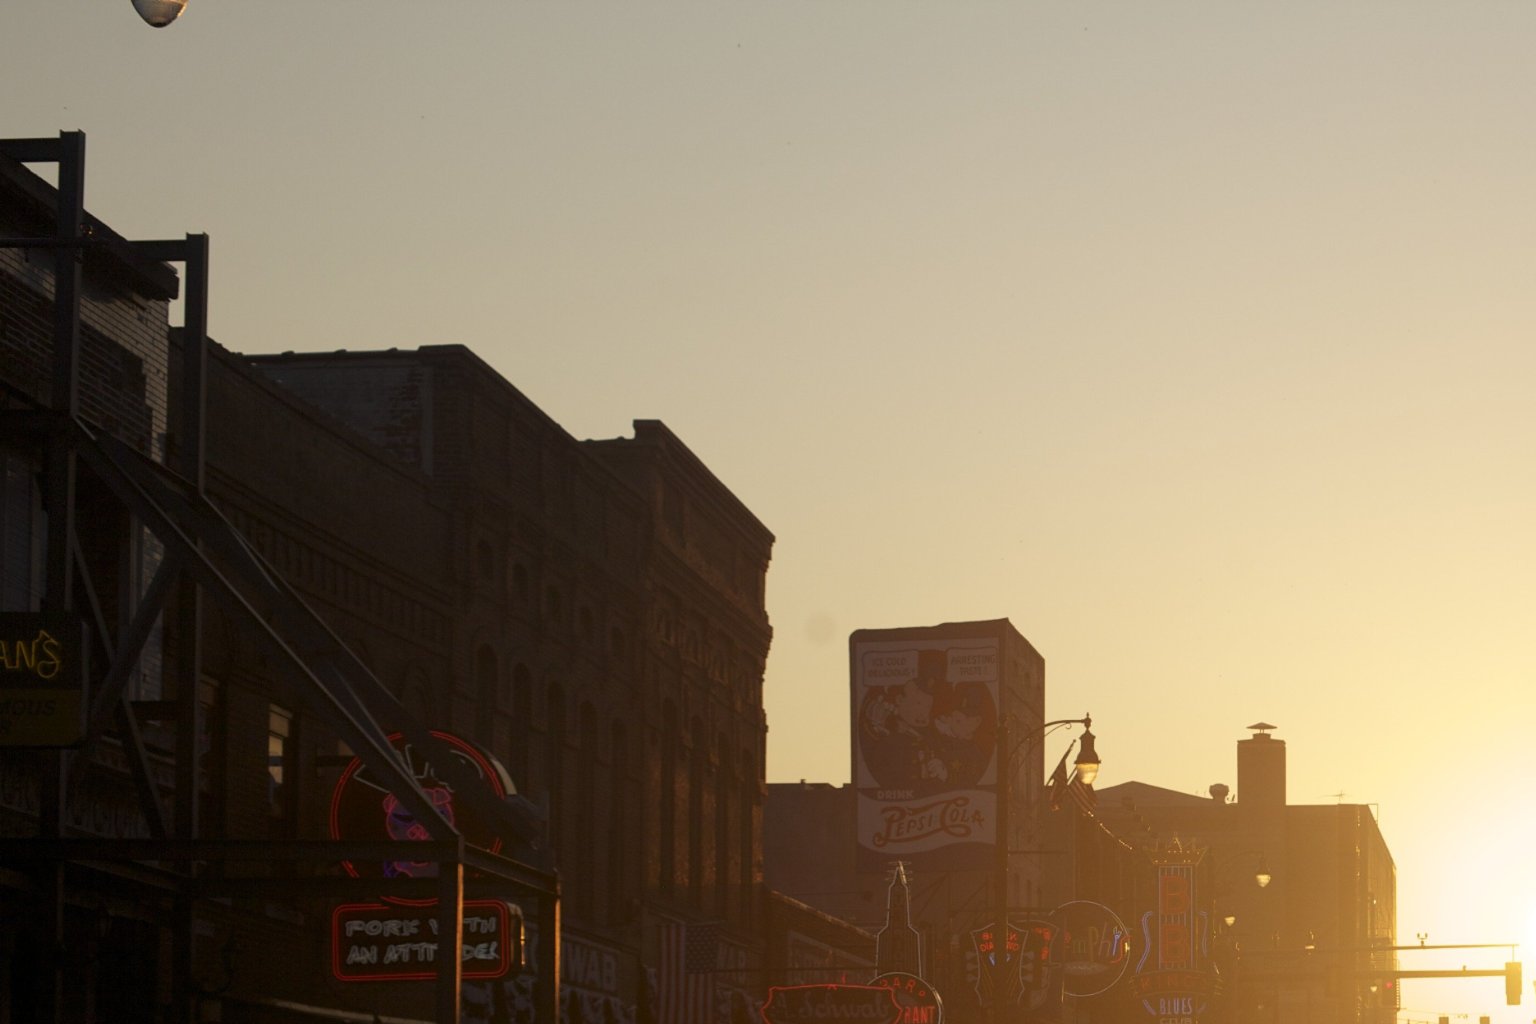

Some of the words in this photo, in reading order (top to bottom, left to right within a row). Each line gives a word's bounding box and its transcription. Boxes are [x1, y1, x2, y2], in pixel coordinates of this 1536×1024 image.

[877, 788, 915, 800] DRINK
[345, 918, 420, 938] PORK
[345, 944, 379, 965] AN
[1159, 996, 1193, 1016] BLUES
